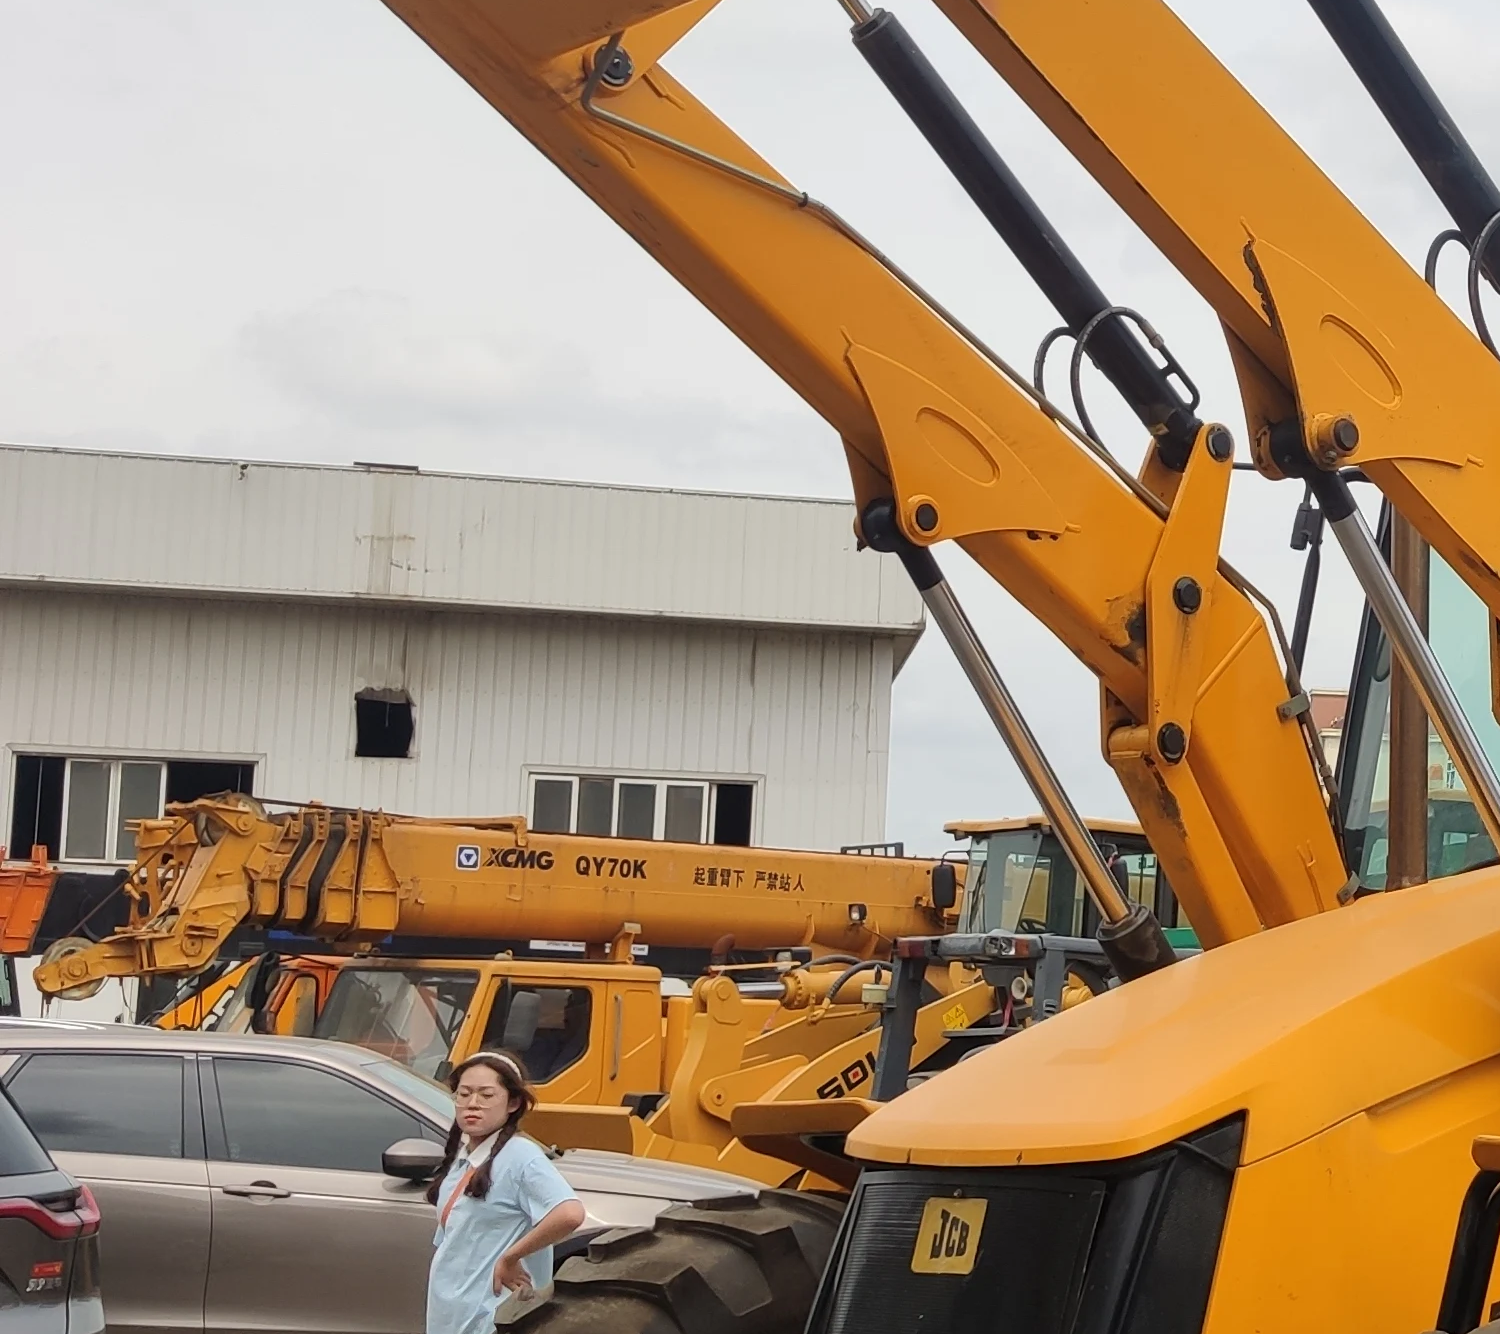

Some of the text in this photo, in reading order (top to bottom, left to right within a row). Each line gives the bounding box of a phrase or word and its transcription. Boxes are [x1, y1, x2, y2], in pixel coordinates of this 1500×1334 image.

[483, 848, 648, 880] XCMG QY70K
[693, 866, 805, 892] 起重臂下 严禁站人
[929, 1208, 970, 1260] JCB
